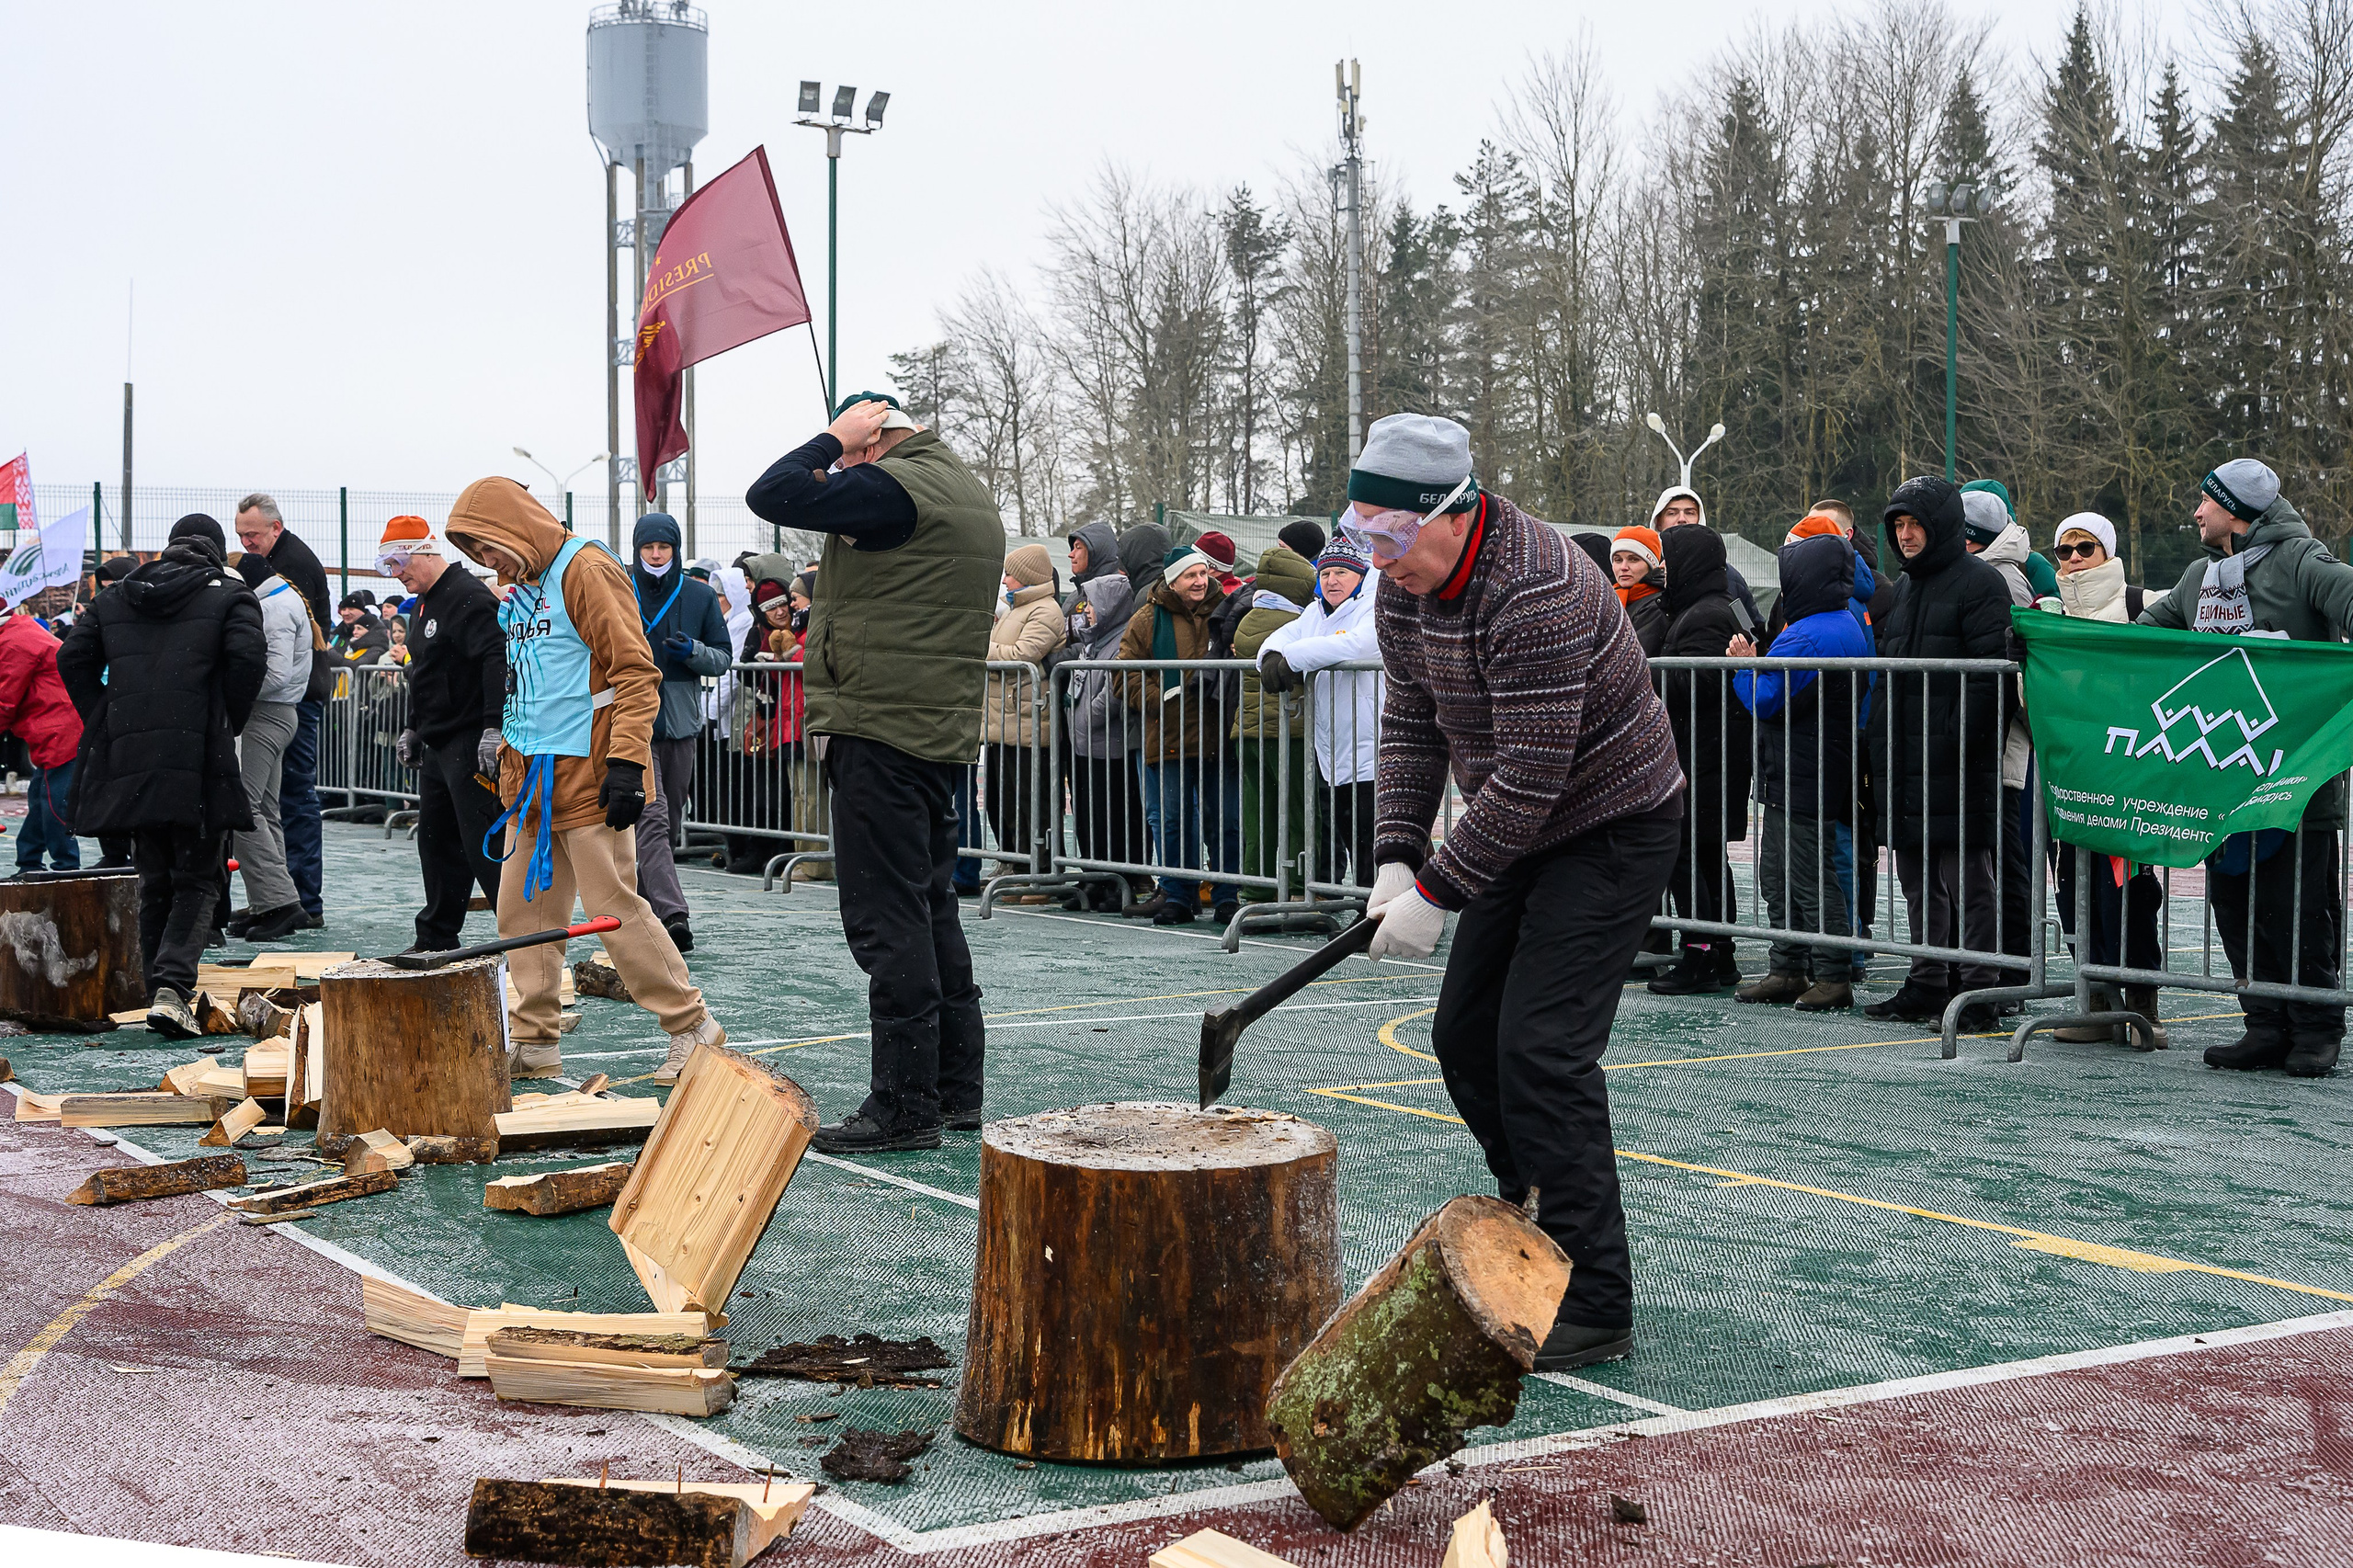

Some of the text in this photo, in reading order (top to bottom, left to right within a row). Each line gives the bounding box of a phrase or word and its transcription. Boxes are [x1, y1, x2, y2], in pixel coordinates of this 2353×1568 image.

[1419, 489, 1477, 505] БЕЛРУСЬ
[2206, 478, 2236, 511] БЕЛАРУСЬ
[2200, 604, 2246, 622] ЕДИНЫЕ
[506, 619, 551, 643] УДЬЯ
[2122, 796, 2209, 821] учреждение
[2086, 813, 2128, 830] делами
